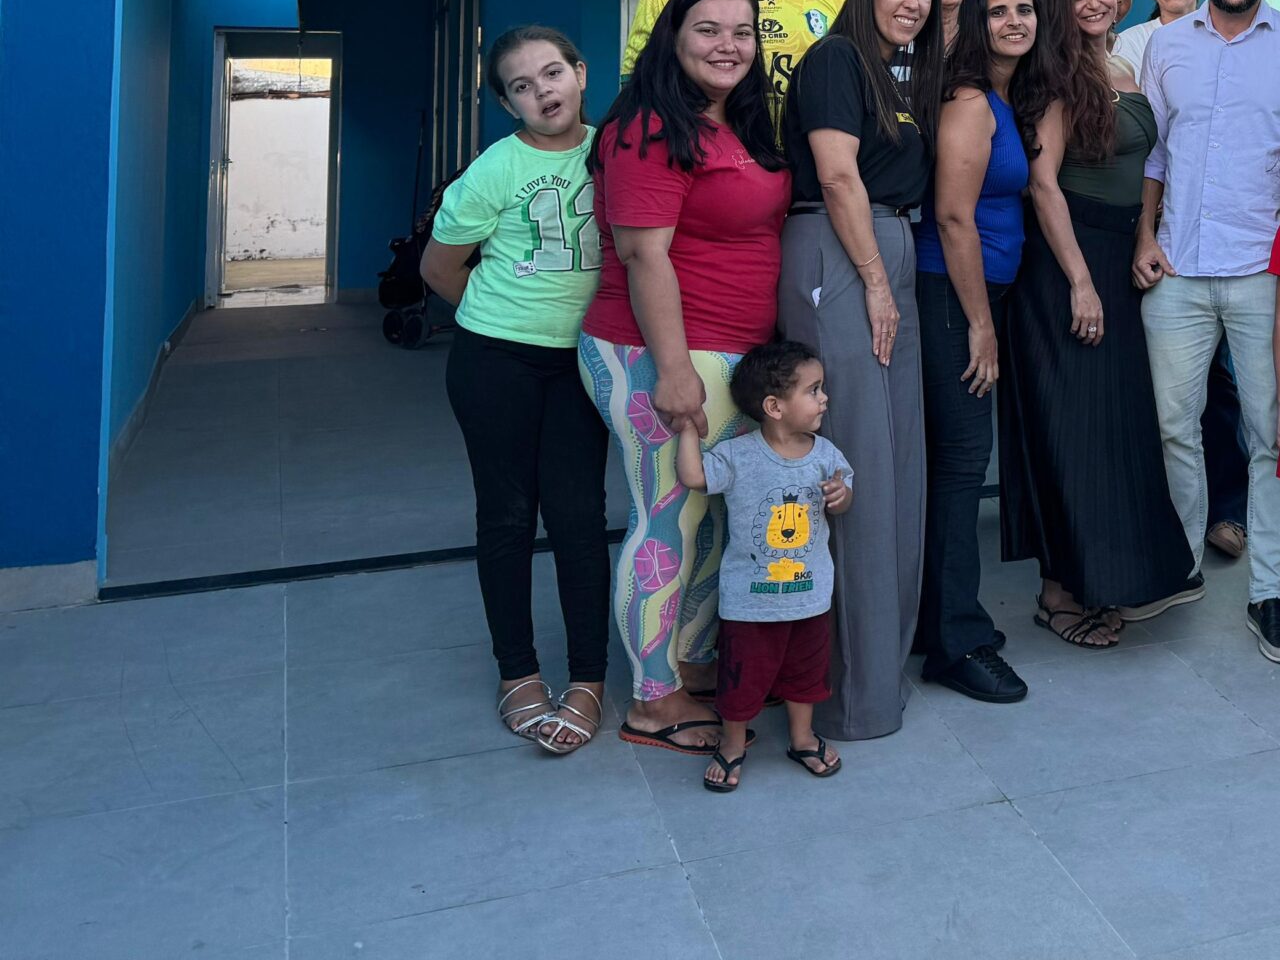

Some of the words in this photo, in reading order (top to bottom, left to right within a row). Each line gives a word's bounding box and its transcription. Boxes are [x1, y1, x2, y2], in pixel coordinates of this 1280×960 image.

[515, 193, 525, 201] I
[520, 175, 548, 195] LOVE
[550, 174, 572, 190] YOU
